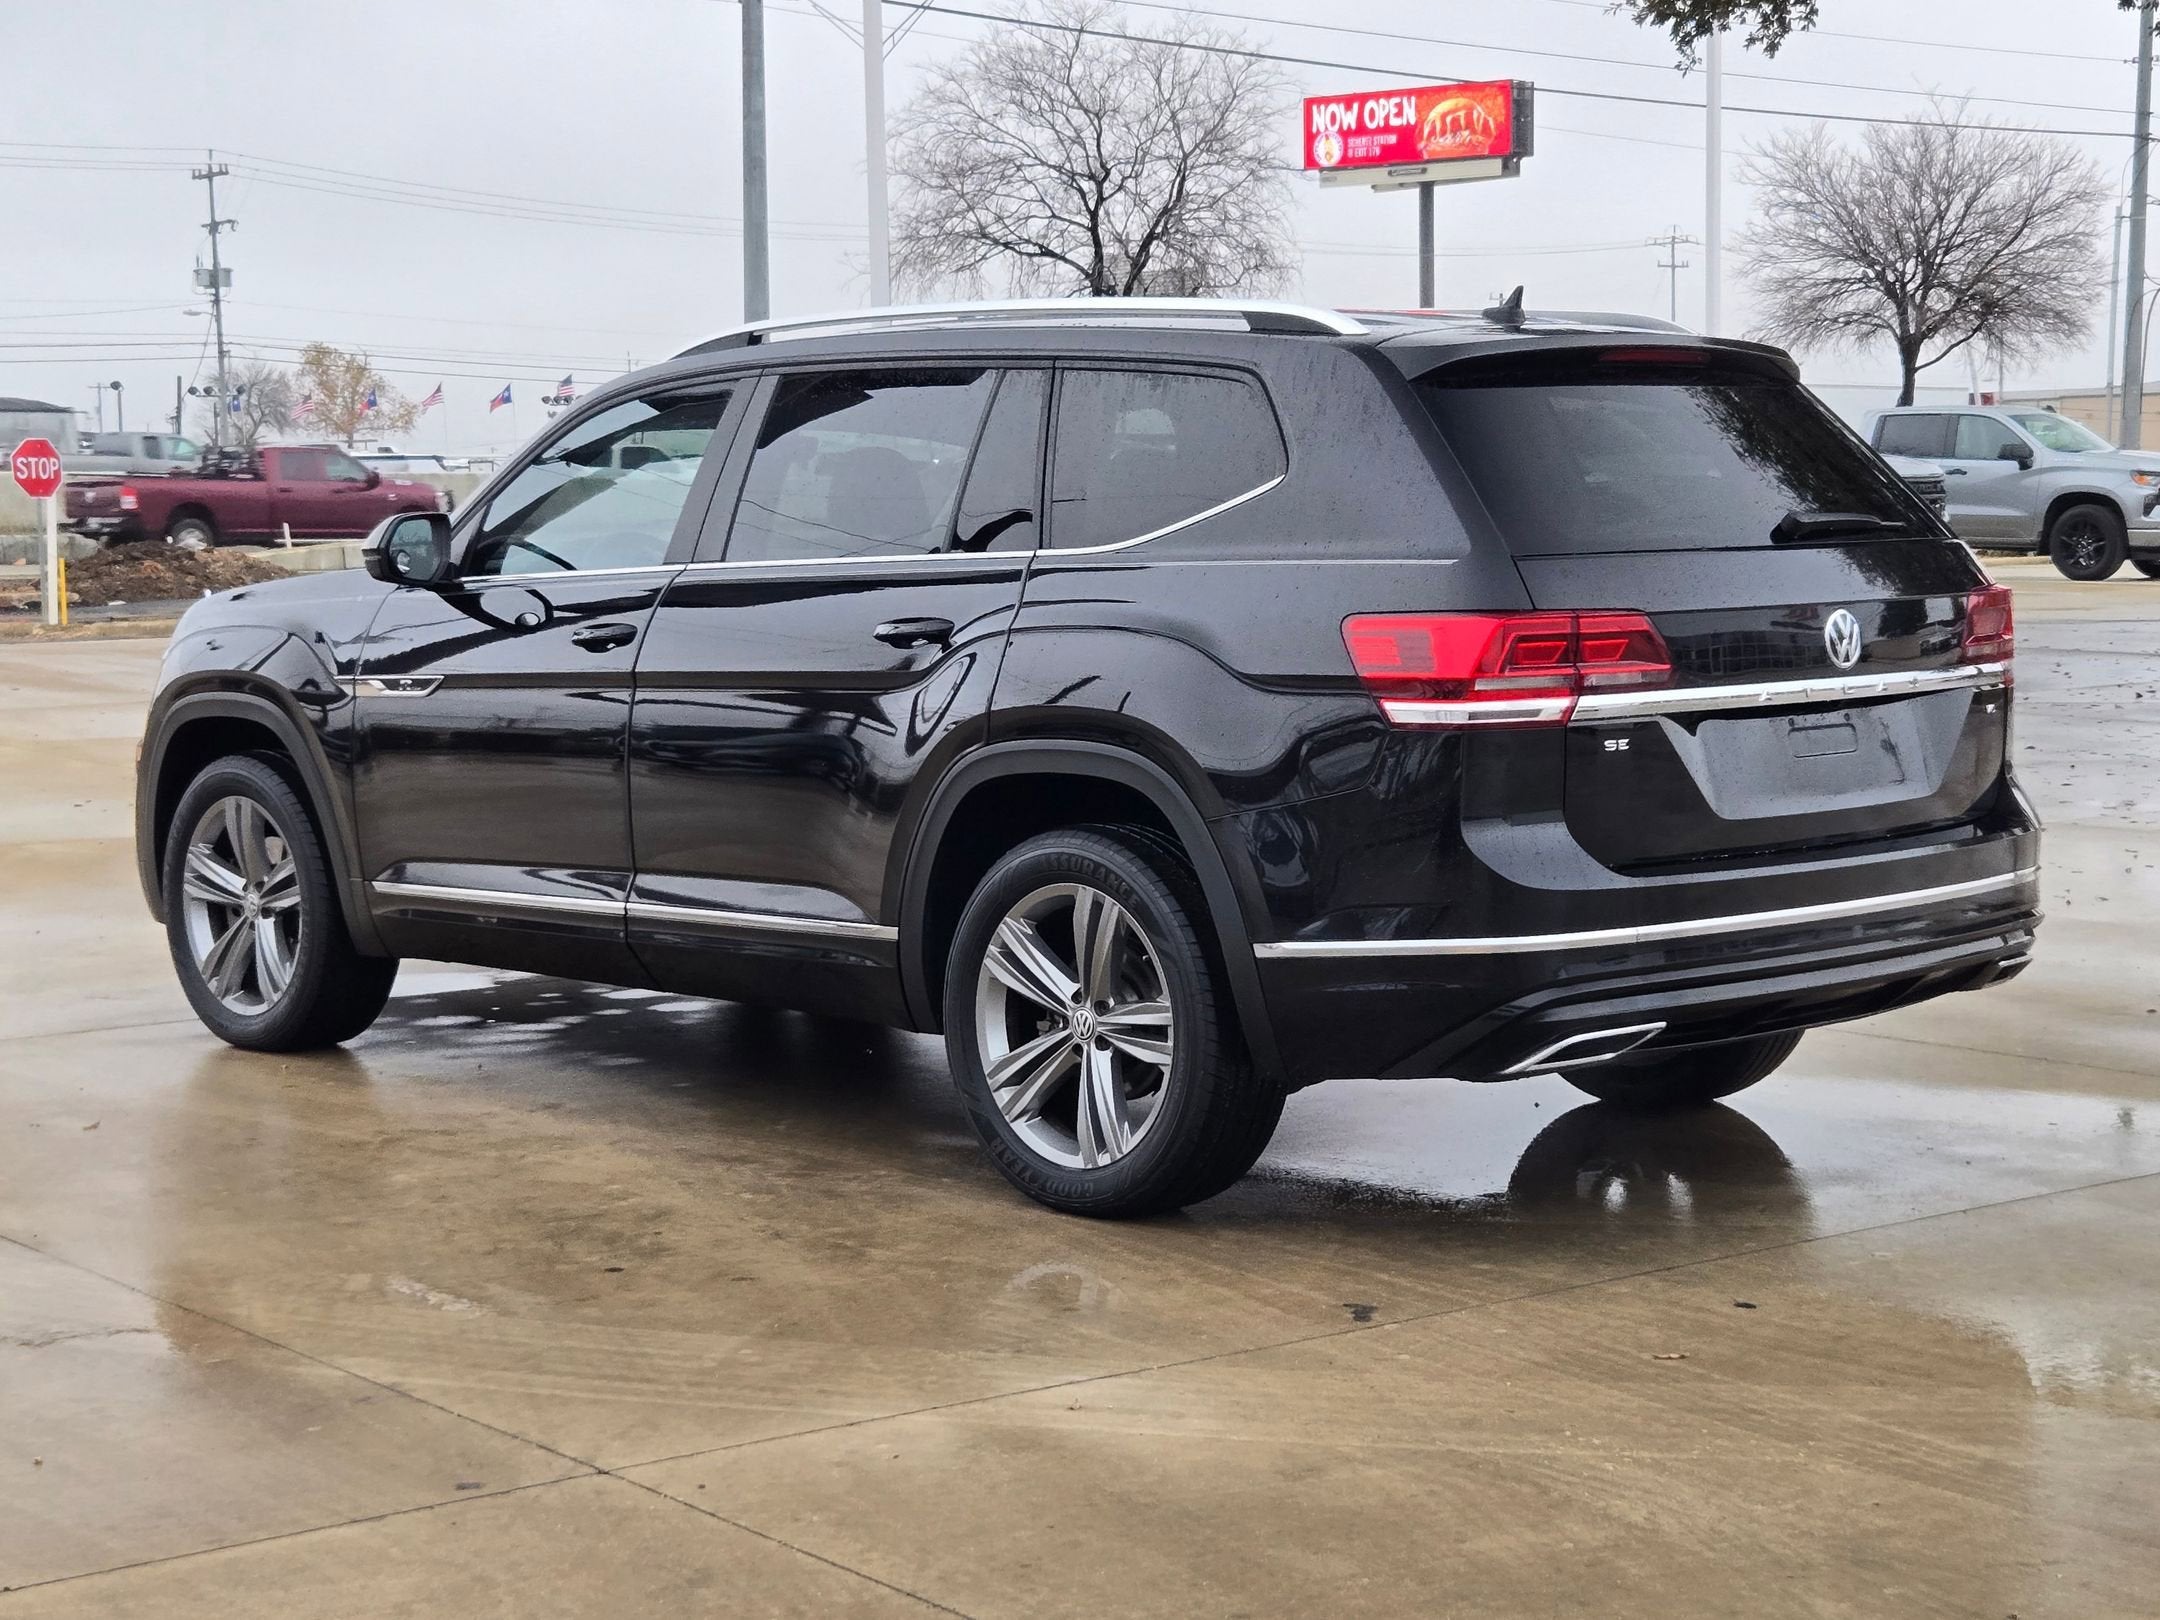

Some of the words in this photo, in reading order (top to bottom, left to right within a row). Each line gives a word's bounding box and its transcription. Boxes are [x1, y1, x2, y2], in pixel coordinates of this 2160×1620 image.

[1312, 102, 1359, 134] NOW
[1364, 96, 1416, 129] OPEN
[16, 457, 60, 480] STOP
[1825, 609, 1860, 669] VW
[1604, 739, 1630, 751] SE
